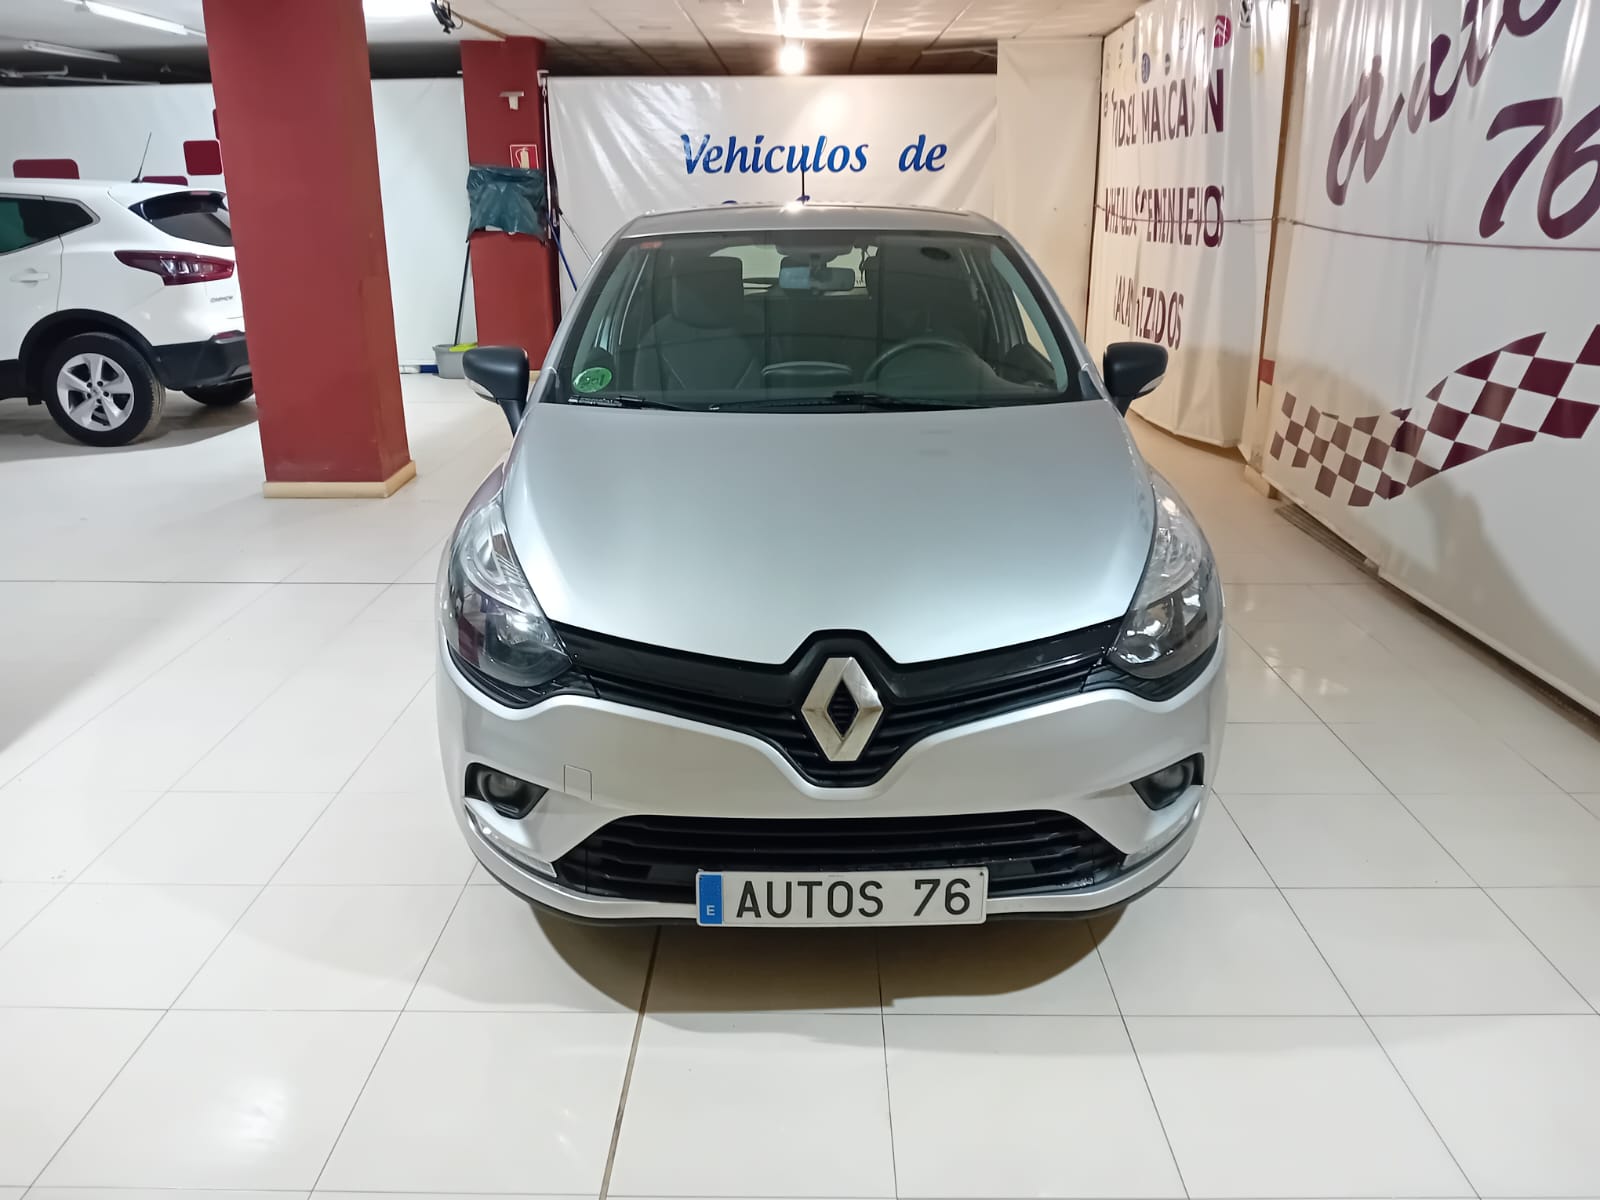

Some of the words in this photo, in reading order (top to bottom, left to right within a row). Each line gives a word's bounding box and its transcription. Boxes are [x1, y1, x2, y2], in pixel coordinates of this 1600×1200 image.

[898, 133, 947, 171] de
[1479, 97, 1600, 239] 76
[706, 905, 715, 916] E
[736, 881, 883, 918] AUTOS
[913, 879, 971, 916] 76
